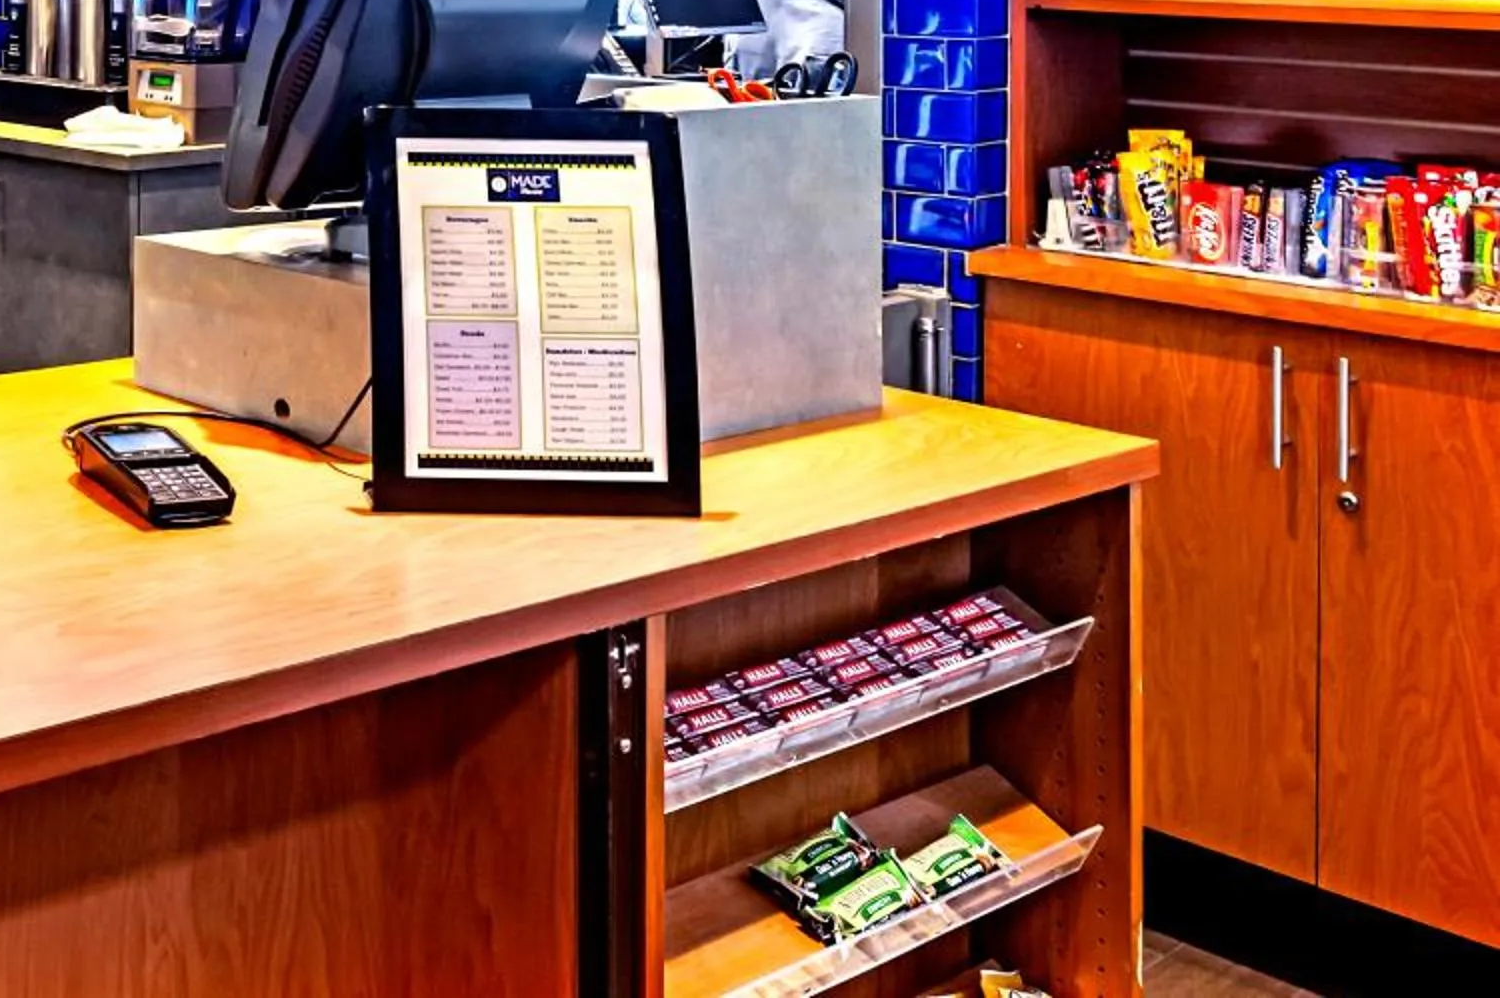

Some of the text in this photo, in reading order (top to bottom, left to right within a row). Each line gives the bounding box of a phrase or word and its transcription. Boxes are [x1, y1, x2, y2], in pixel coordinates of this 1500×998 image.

[511, 175, 552, 189] MADE
[1427, 204, 1462, 296] Skittles
[949, 601, 980, 617] HALLS
[884, 622, 917, 639] HALLS
[968, 618, 999, 635] HALLS
[817, 643, 850, 661] HALLS
[902, 639, 936, 655] HALLS
[745, 665, 781, 681] HALLS
[837, 661, 871, 679] HALLS
[672, 691, 708, 708] HALLS
[769, 685, 802, 704] HALLS
[691, 709, 728, 727] HALLS
